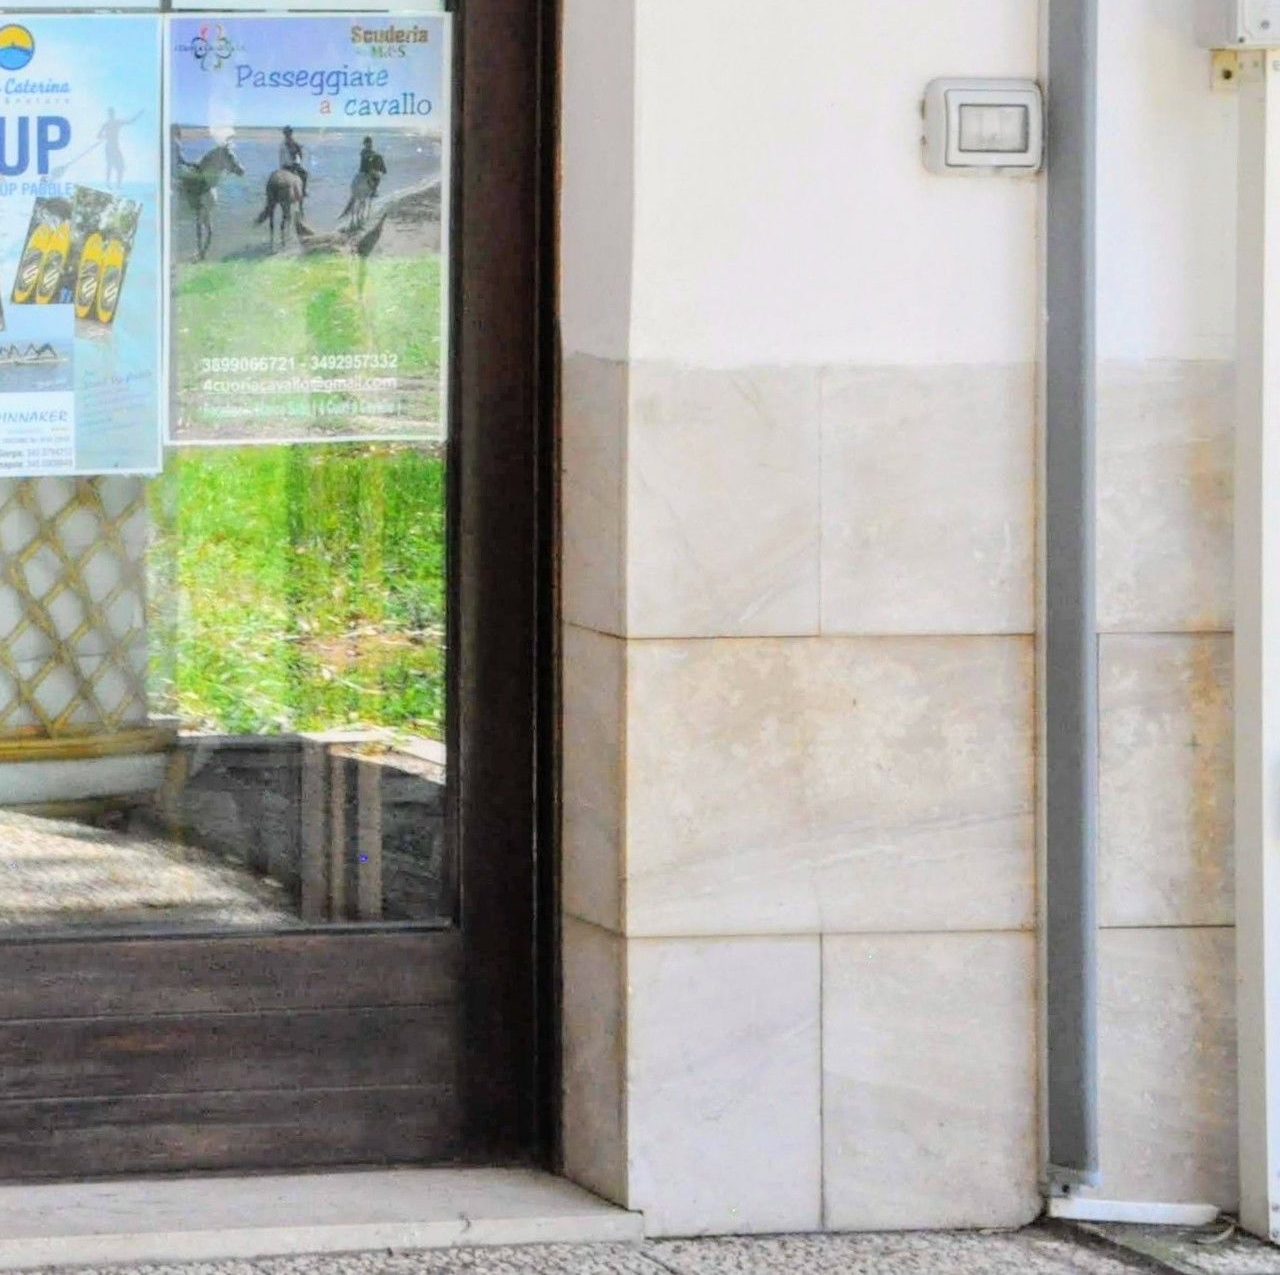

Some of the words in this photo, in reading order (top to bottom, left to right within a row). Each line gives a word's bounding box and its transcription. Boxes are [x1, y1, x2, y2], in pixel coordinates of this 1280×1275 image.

[351, 25, 429, 44] Scuderia
[5, 77, 71, 95] Caterina
[235, 65, 390, 96] Passeggiate
[319, 99, 332, 115] a
[344, 93, 433, 117] cavallo
[0, 182, 17, 197] UP
